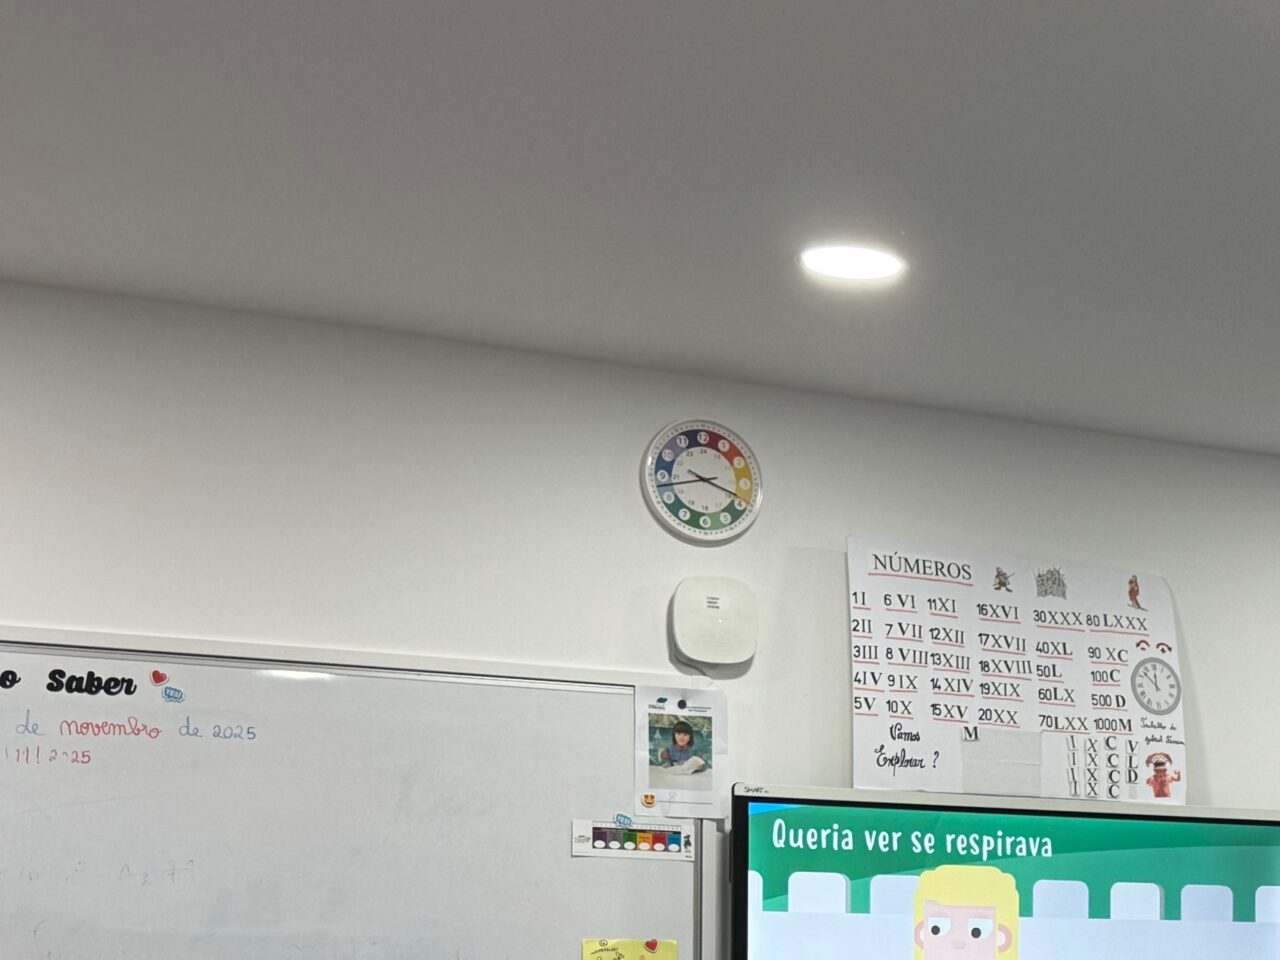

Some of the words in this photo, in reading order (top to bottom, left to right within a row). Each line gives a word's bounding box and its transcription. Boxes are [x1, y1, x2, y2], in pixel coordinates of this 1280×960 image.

[678, 437, 687, 445] 11
[699, 433, 708, 442] 12
[664, 450, 673, 459] 10
[660, 472, 666, 480] 9
[737, 500, 743, 508] 4
[681, 511, 688, 519] 7
[702, 517, 708, 526] 6
[872, 551, 972, 580] NÚMEROS
[884, 594, 892, 606] 6
[897, 593, 916, 609] VI
[1086, 614, 1100, 627] 80
[1103, 613, 1148, 631] LXXX
[885, 624, 893, 636] 7
[898, 622, 923, 639] VII
[886, 648, 893, 660] 8
[898, 648, 929, 665] VIII
[1088, 647, 1101, 659] 90
[1106, 647, 1128, 662] XC
[46, 669, 137, 695] Saber
[888, 675, 895, 687] 9
[900, 675, 918, 690] IX
[1091, 694, 1112, 707] 500
[1115, 695, 1126, 707] D
[15, 709, 44, 736] de
[60, 716, 162, 739] novembro
[178, 716, 203, 738] de
[212, 725, 257, 741] 2025
[890, 722, 921, 742] Vamos
[963, 726, 979, 740] M
[1087, 738, 1098, 752] X
[1106, 736, 1117, 750] C
[1128, 740, 1139, 753] V
[874, 744, 926, 777] Explorar
[1088, 753, 1098, 767] X
[1107, 753, 1119, 768] C
[1129, 755, 1138, 768] L
[1087, 768, 1098, 781] X
[1109, 769, 1120, 784] C
[1128, 769, 1138, 783] D
[1088, 783, 1098, 796] X
[1109, 784, 1120, 798] C
[772, 818, 854, 851] Queria
[864, 829, 902, 853] ver
[911, 830, 935, 854] se
[946, 830, 1053, 862] respirava
